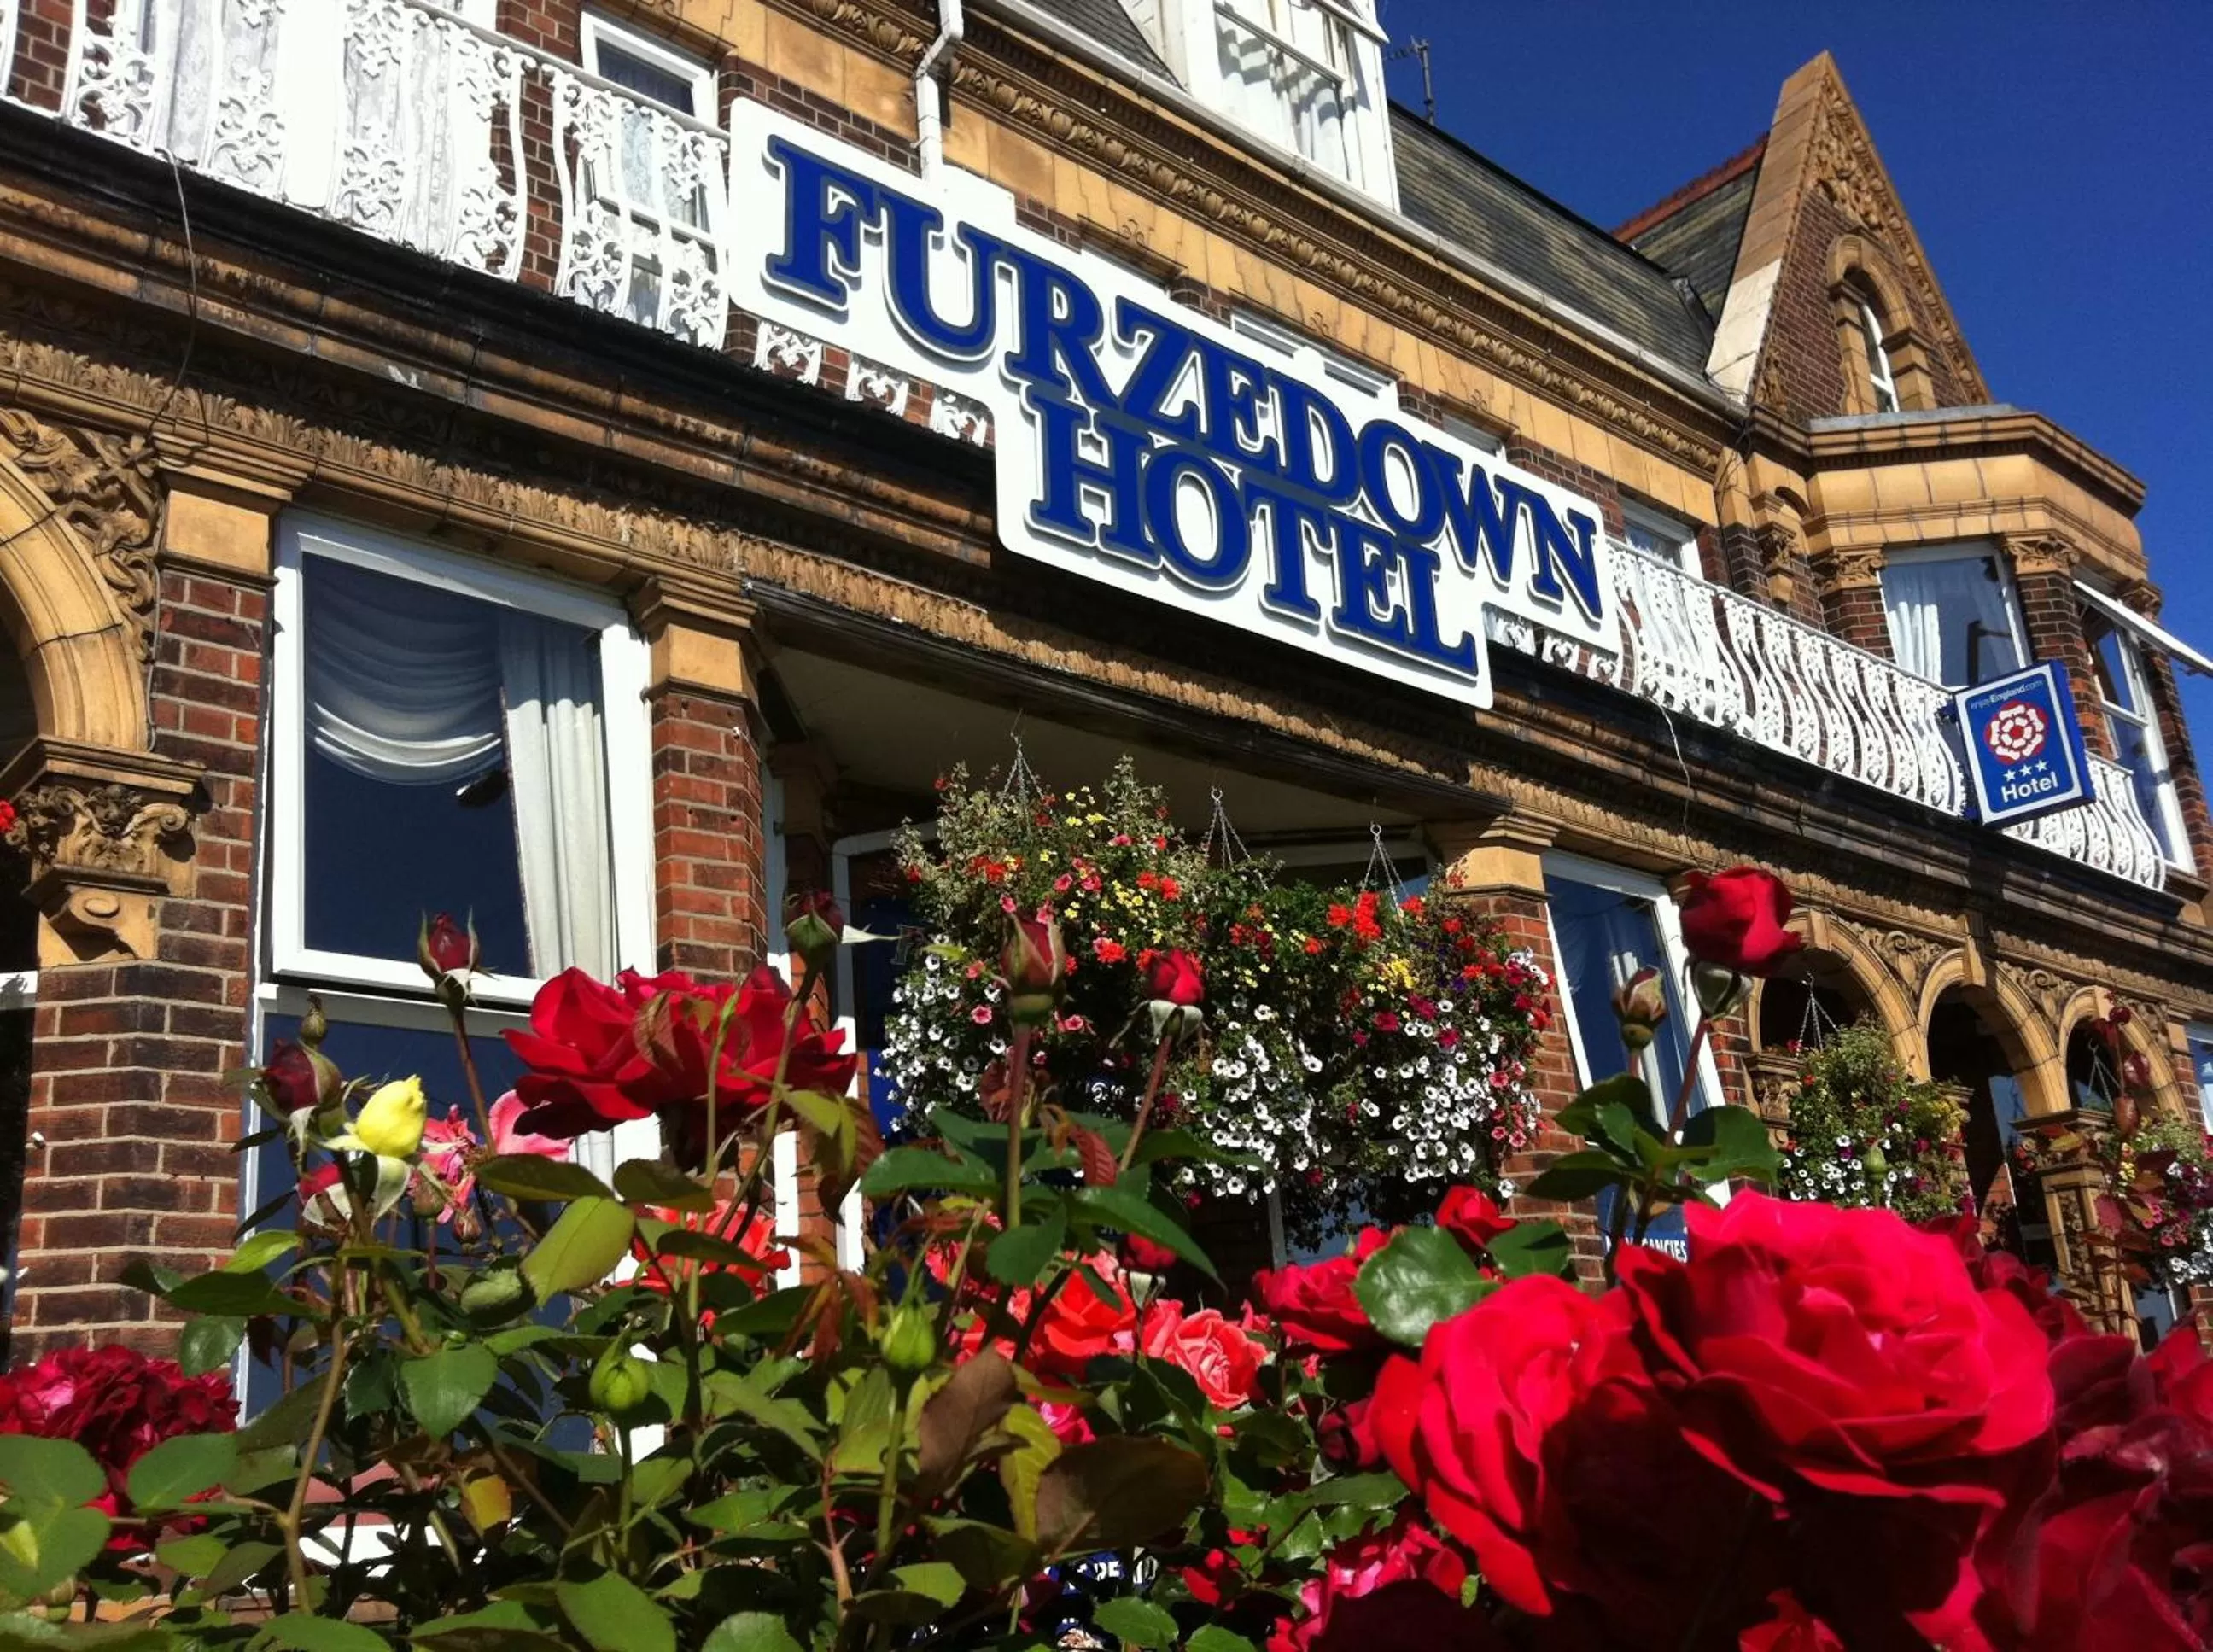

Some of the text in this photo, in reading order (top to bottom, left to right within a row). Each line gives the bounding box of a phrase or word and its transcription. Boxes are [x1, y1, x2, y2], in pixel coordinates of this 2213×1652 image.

[764, 132, 1604, 621] FURZEDOWN
[1027, 384, 1478, 678] HOTEL
[2000, 771, 2059, 803] Hotel
[1625, 1237, 1688, 1264] ANCIES
